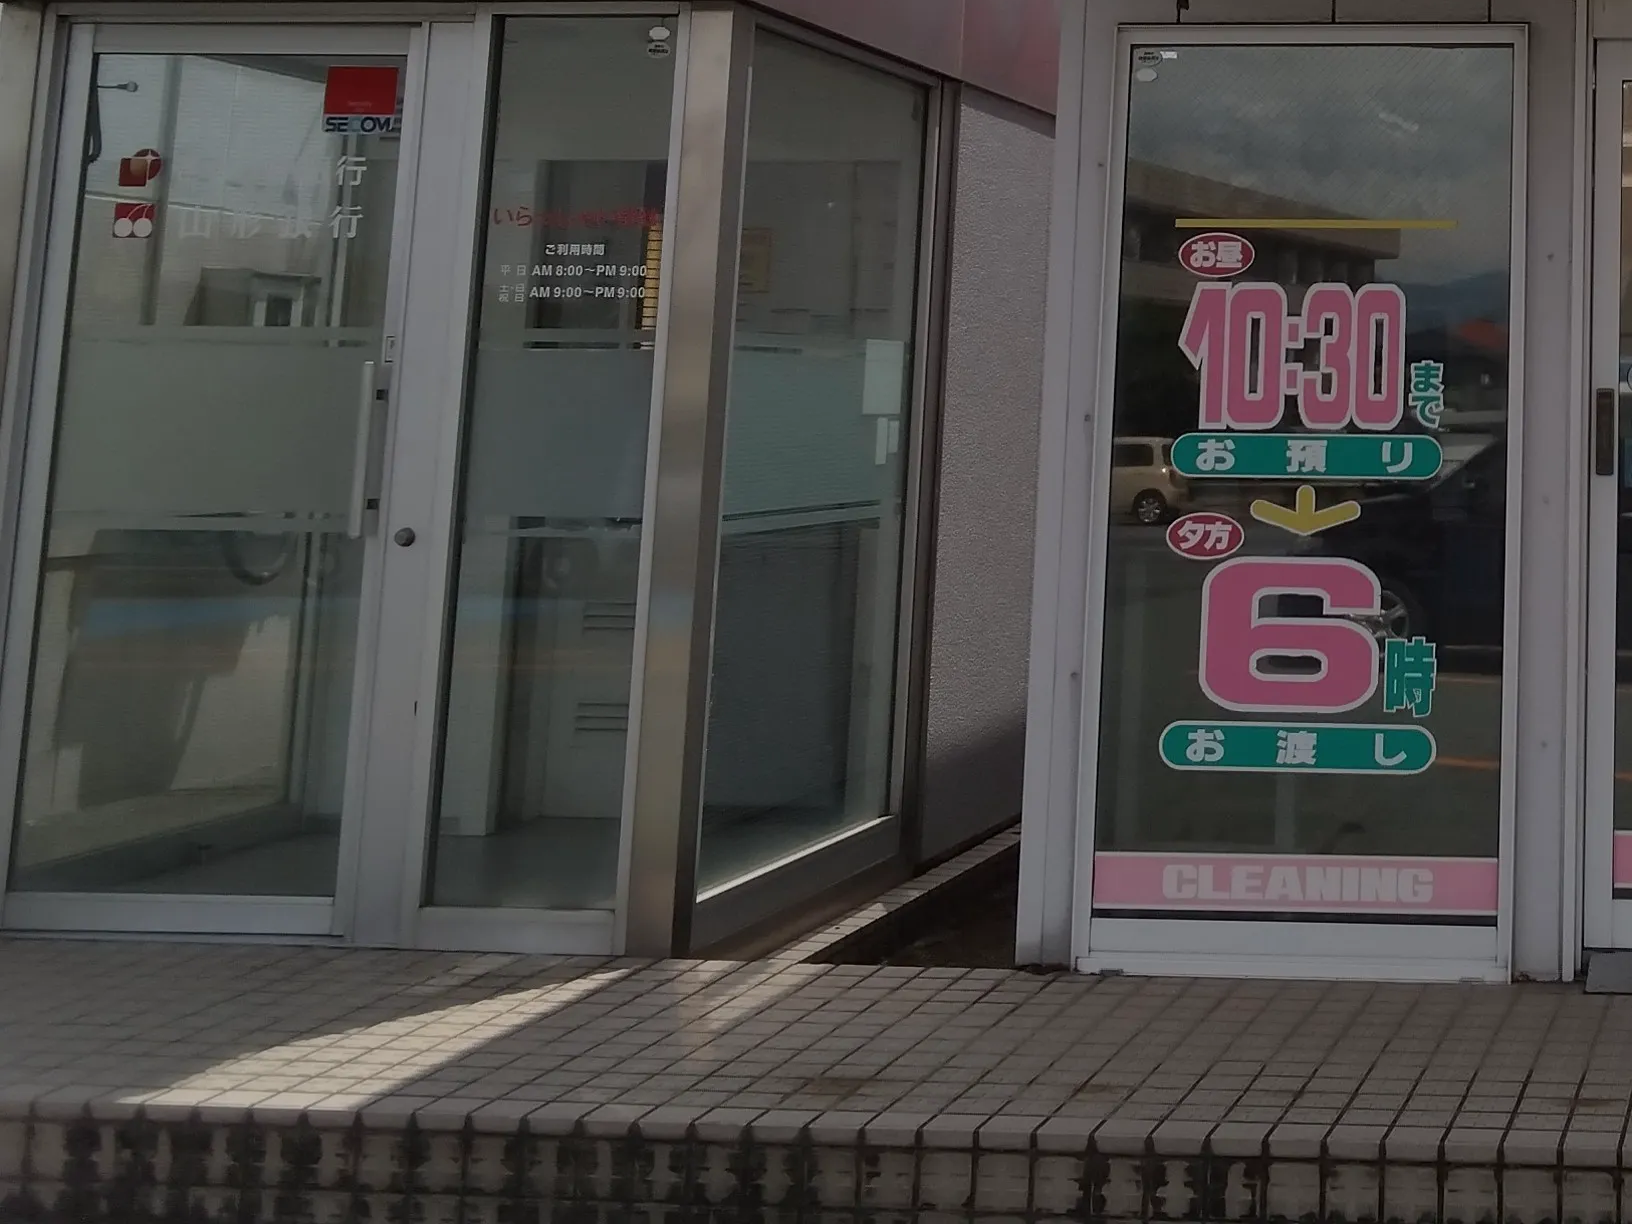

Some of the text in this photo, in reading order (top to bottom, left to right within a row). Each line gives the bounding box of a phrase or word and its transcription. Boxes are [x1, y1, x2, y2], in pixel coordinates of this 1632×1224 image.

[545, 243, 606, 256] ご利用時間
[1188, 239, 1245, 271] お昼
[531, 265, 552, 276] AM
[529, 287, 550, 298] AM
[1178, 281, 1406, 431] 10:30
[1409, 359, 1444, 428] まで
[1195, 437, 1415, 474] お預り
[1175, 518, 1233, 550] 夕方
[1184, 728, 1408, 766] お渡し
[1162, 864, 1433, 904] CLEANING
